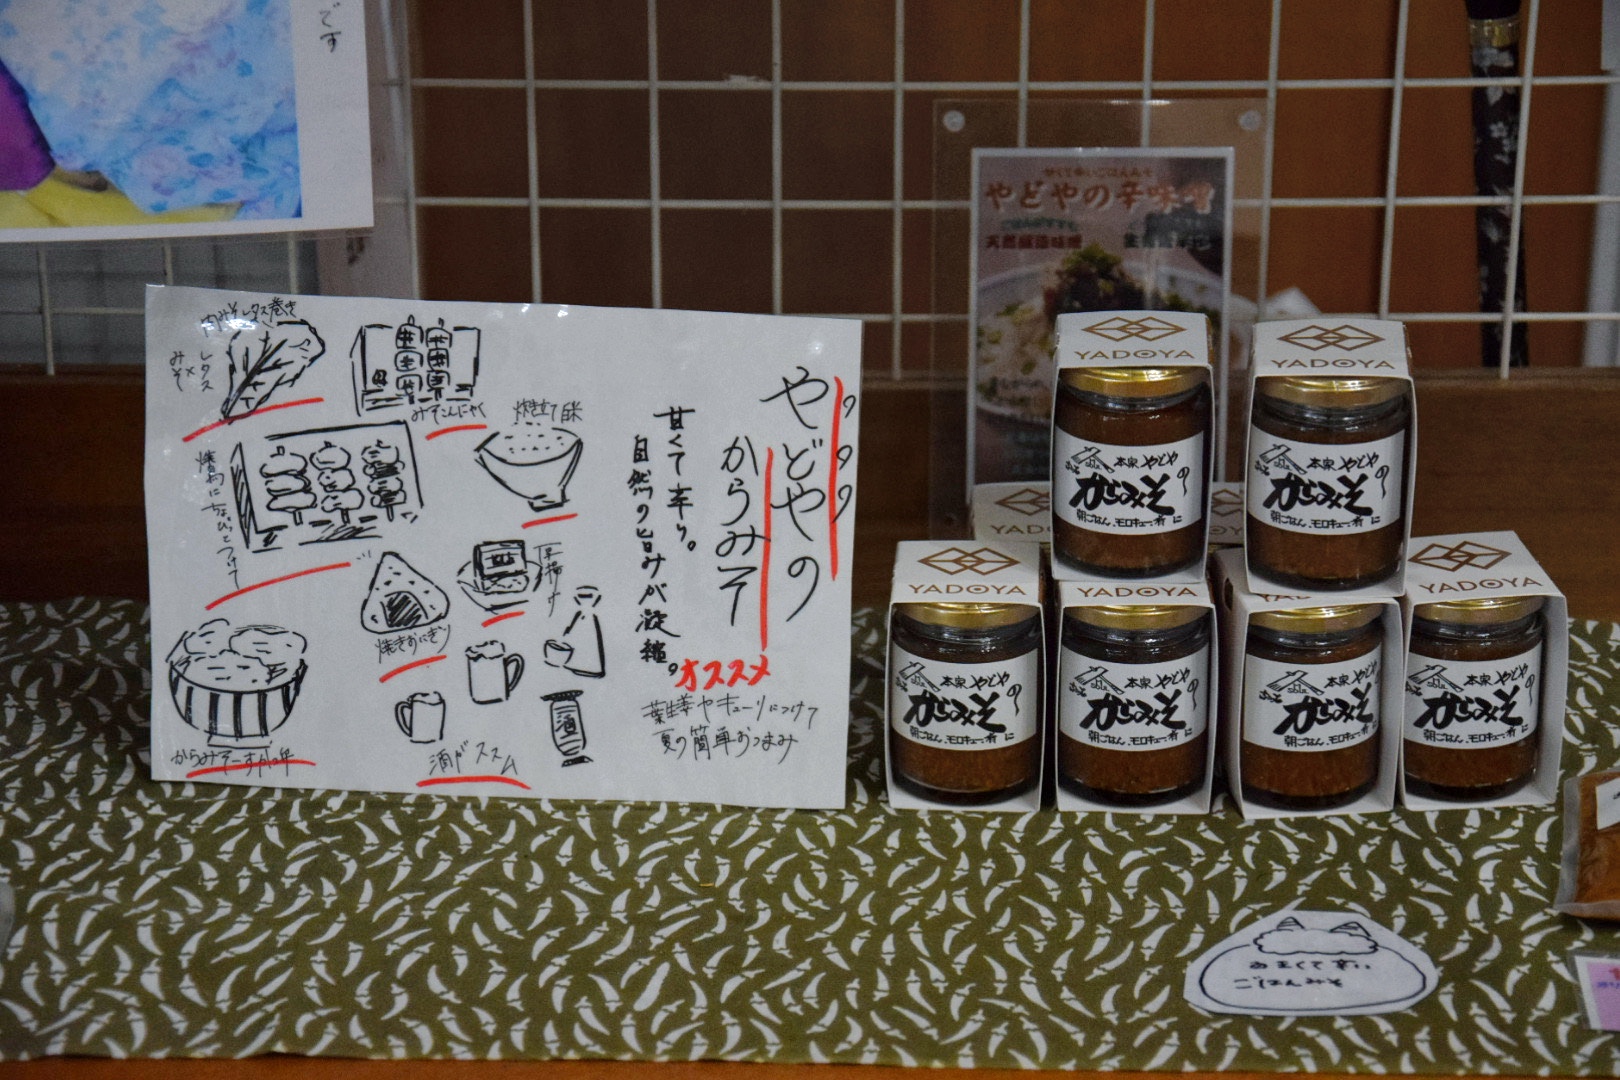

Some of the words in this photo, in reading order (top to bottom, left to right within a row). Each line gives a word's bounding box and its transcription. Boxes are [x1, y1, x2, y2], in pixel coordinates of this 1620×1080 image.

[1074, 349, 1195, 360] YADOYA
[1271, 359, 1395, 369] YADOYA
[760, 366, 829, 623] やどやの
[715, 436, 772, 626] からみそ
[908, 584, 1027, 596] YADOYA
[1077, 587, 1198, 597] YADOYA
[1418, 576, 1543, 594] YADOYA
[674, 654, 771, 692] オススメ
